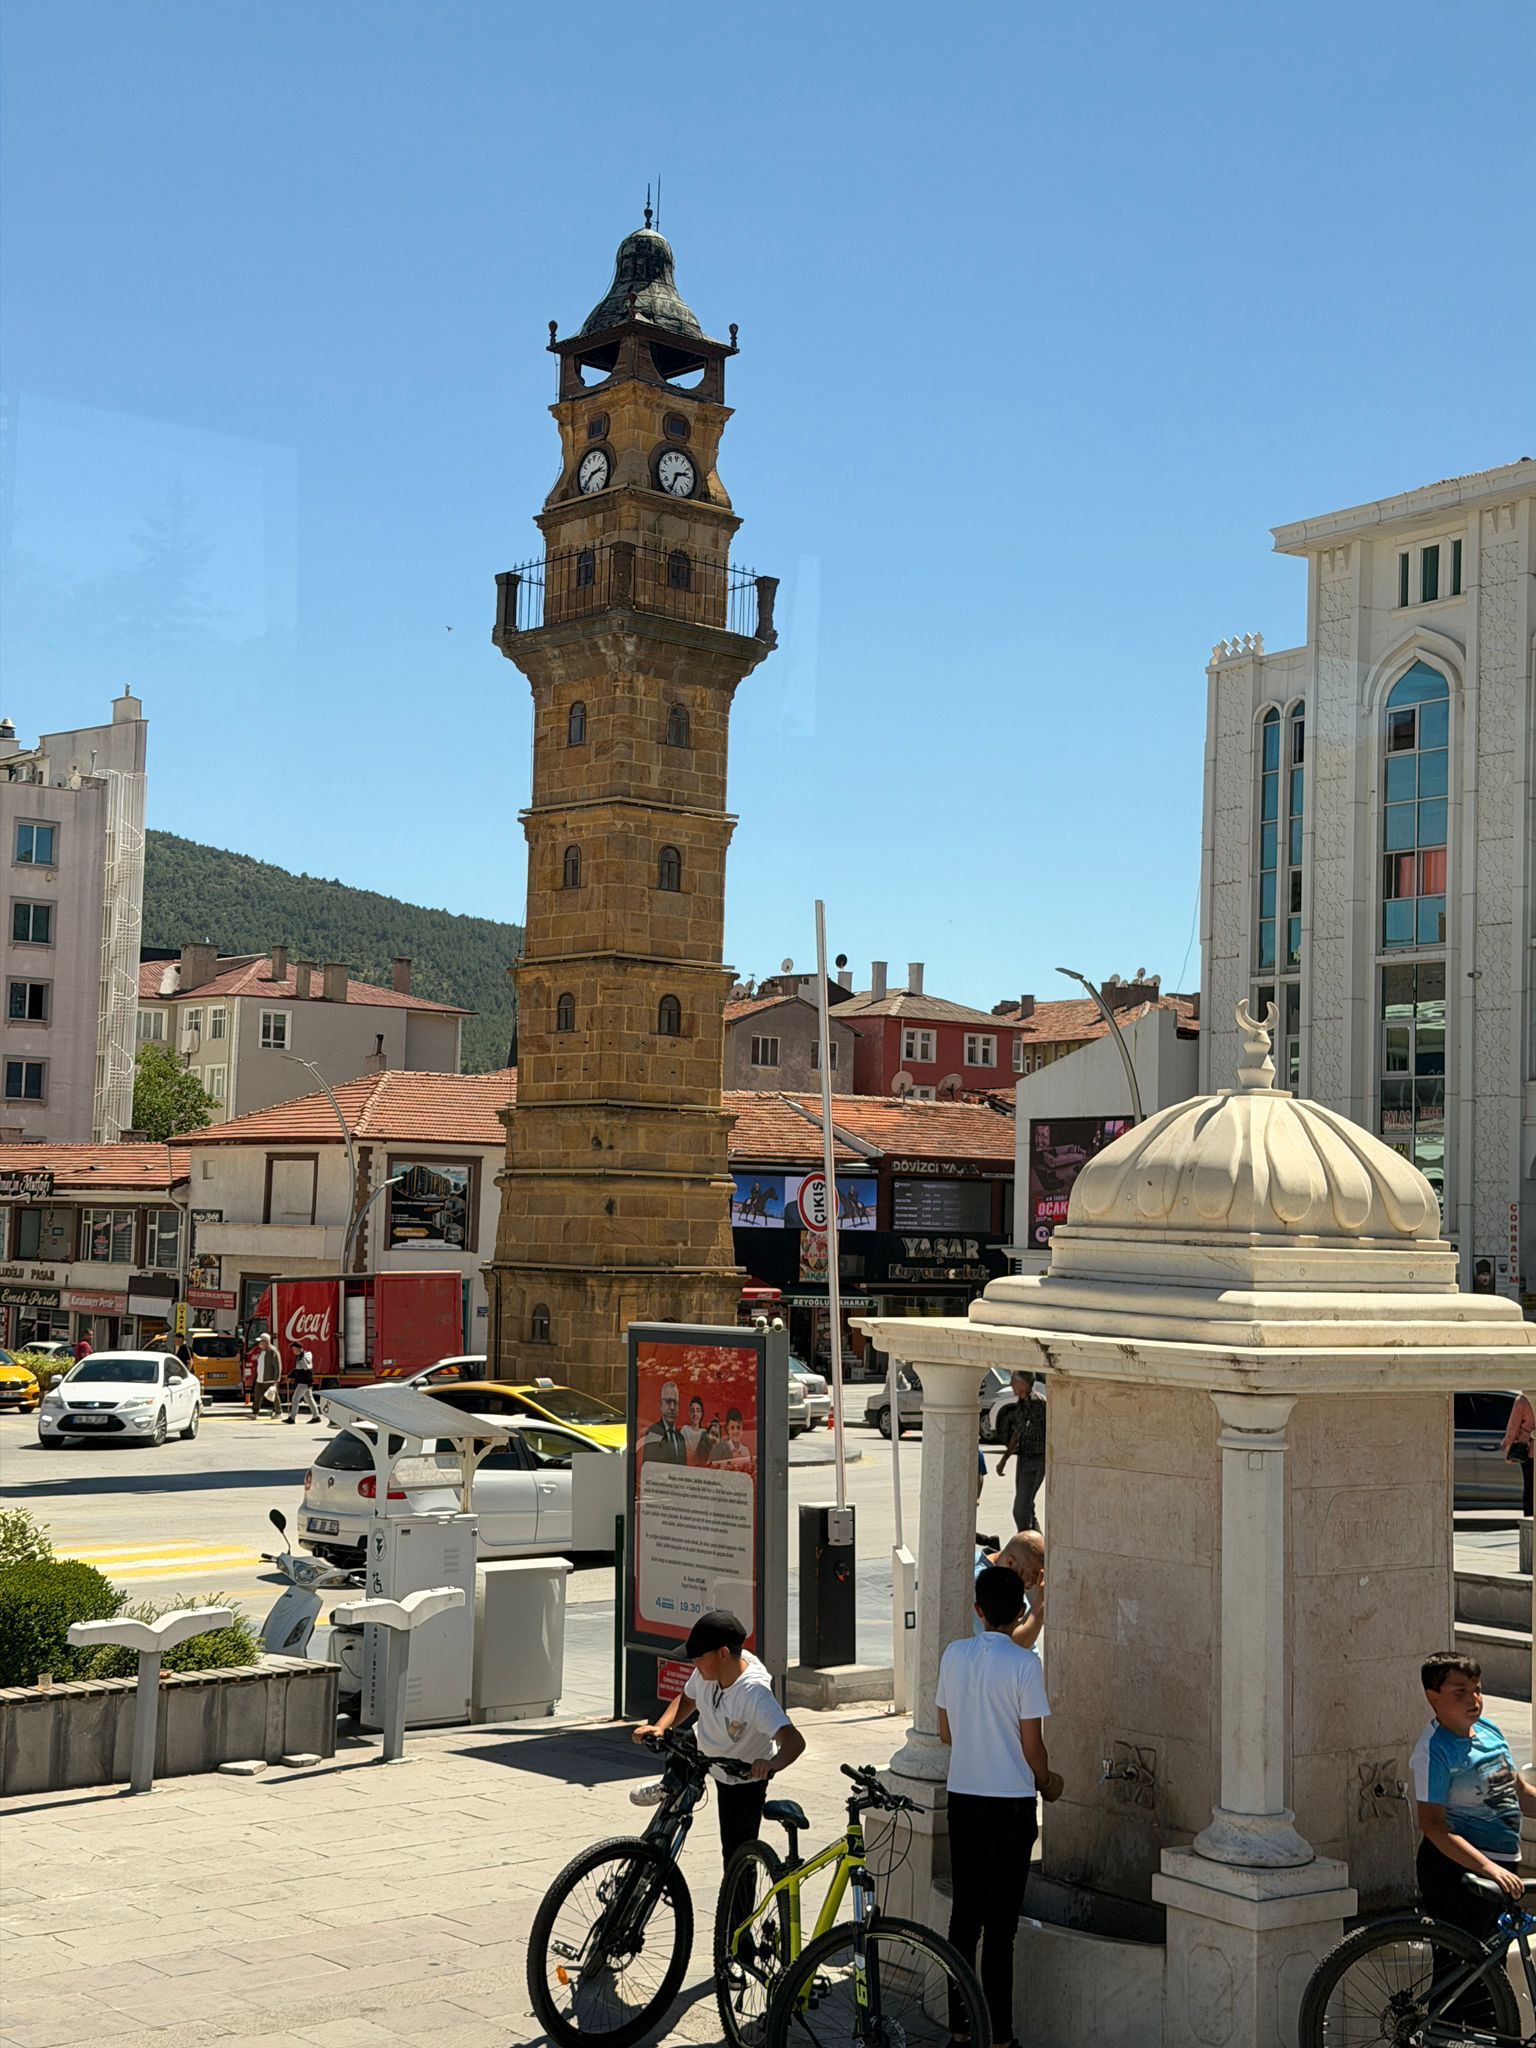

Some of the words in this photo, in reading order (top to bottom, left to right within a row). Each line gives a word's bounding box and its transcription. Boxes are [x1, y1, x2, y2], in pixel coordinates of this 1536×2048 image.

[812, 1181, 827, 1224] ÇIKIŞ
[1038, 1201, 1068, 1216] OCAK
[901, 1237, 979, 1264] YAŞAR
[1509, 1203, 1519, 1284] ÇORBACIM
[1, 1288, 27, 1304] Emek
[28, 1290, 58, 1306] Perde
[793, 1298, 830, 1306] BEYOĞLU
[655, 1596, 662, 1608] 4
[680, 1601, 701, 1614] 19.30
